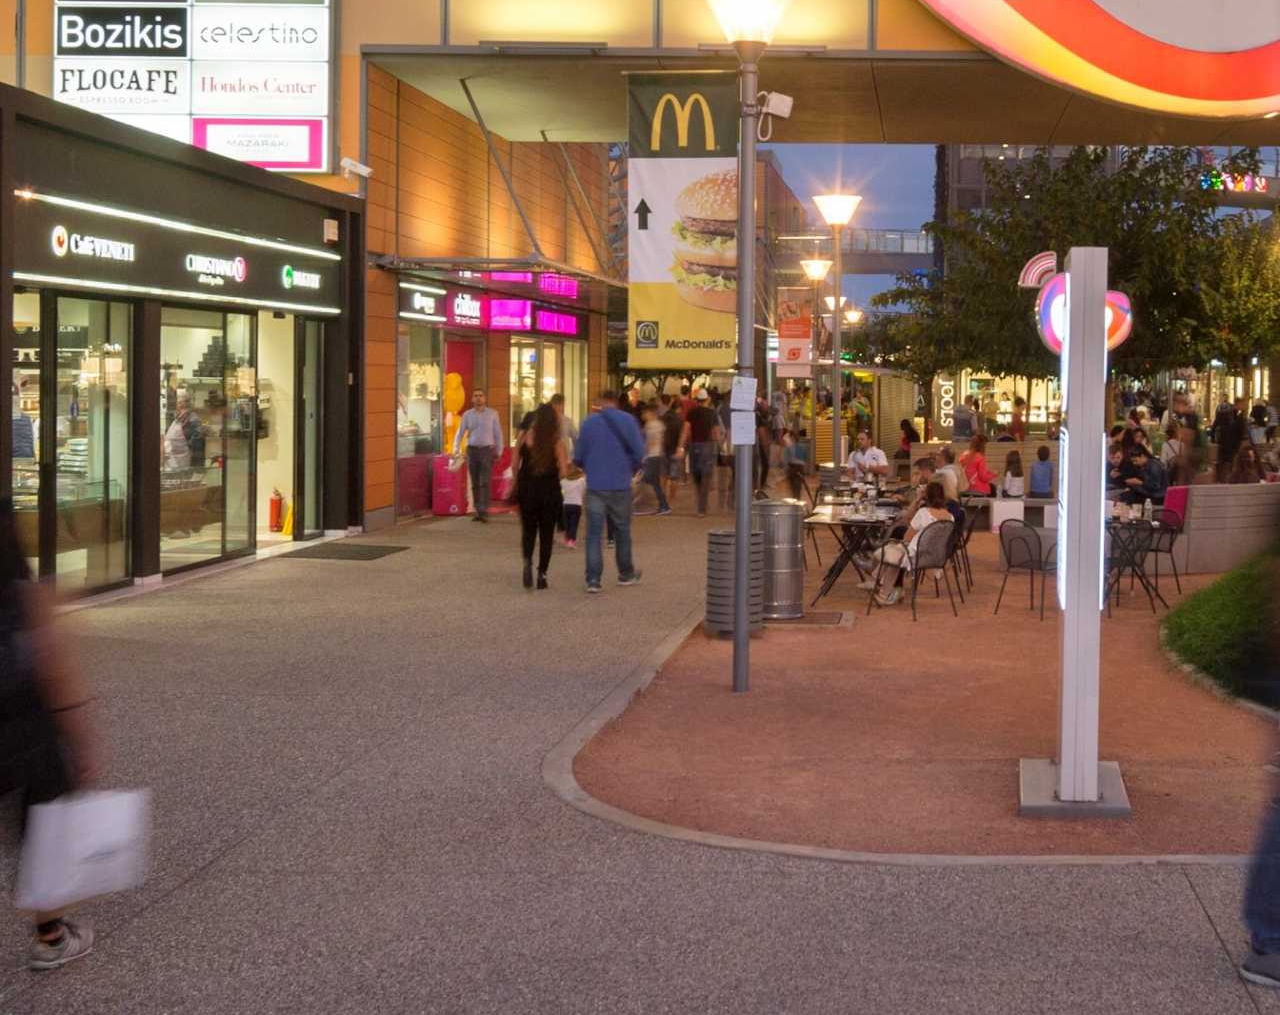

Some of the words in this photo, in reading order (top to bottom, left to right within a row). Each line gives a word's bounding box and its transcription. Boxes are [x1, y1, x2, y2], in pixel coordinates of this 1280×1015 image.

[61, 15, 183, 49] Bozikis
[200, 22, 318, 44] celestino
[60, 69, 178, 95] FLOCAFE
[201, 76, 259, 93] Hondos
[264, 77, 317, 94] Center
[665, 339, 731, 349] McDonald's
[938, 379, 954, 427] JOOLS
